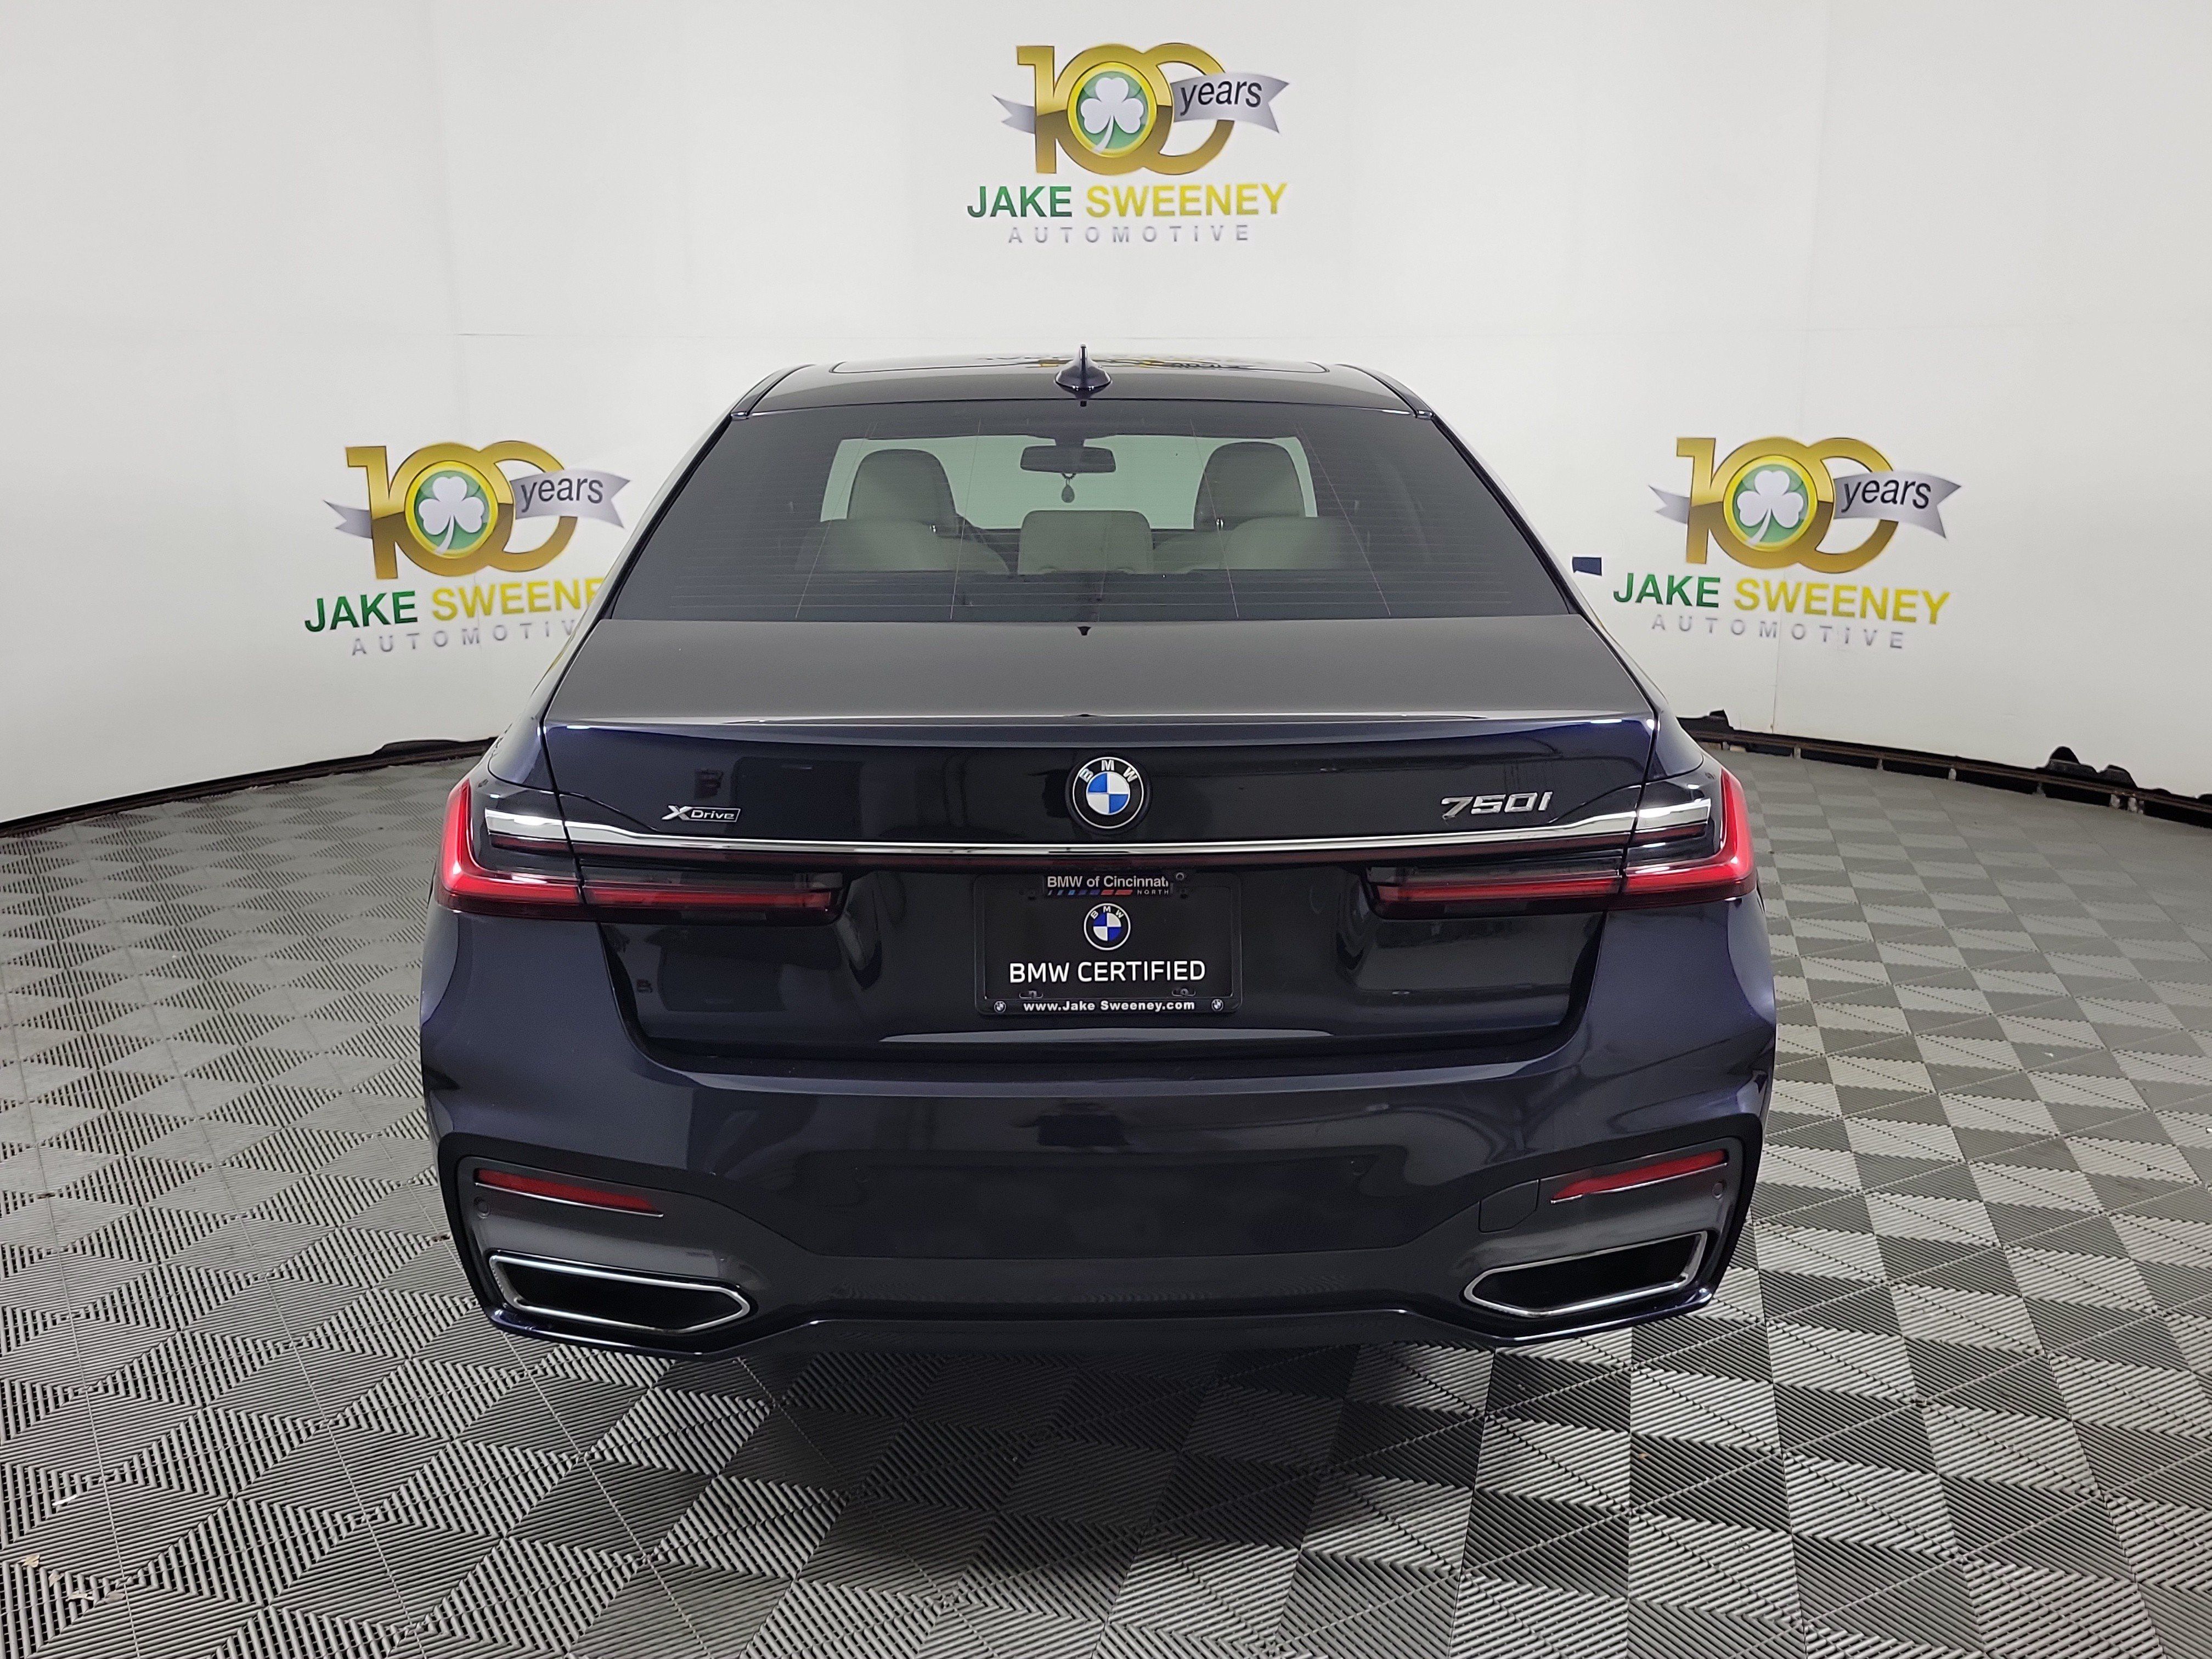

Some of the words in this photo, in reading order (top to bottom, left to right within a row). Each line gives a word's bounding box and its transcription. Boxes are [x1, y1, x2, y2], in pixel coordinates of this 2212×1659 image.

[1179, 81, 1262, 116] years
[967, 185, 1072, 218] JAKE
[1086, 183, 1287, 217] SWEENEY
[1008, 224, 1249, 244] AUTOMOTIVE
[521, 477, 603, 512] years
[1841, 479, 1931, 513] years
[304, 590, 417, 633] JAKE
[432, 577, 603, 622] SWEENE
[1613, 572, 1720, 608] JAKE
[1734, 578, 1951, 624] SWEENEY
[351, 619, 575, 656] AUTOMOTIV
[1651, 615, 1905, 649] AUTOMOTIVE
[1079, 759, 1138, 783] BMW
[1047, 876, 1082, 888] BMW
[1086, 876, 1099, 887] of
[1090, 905, 1124, 919] BMW
[1009, 962, 1069, 983] BMW
[1077, 961, 1205, 981] CERTIFIED
[1023, 1000, 1096, 1012] www.Jake
[1100, 1000, 1195, 1012] Sweeney.com
